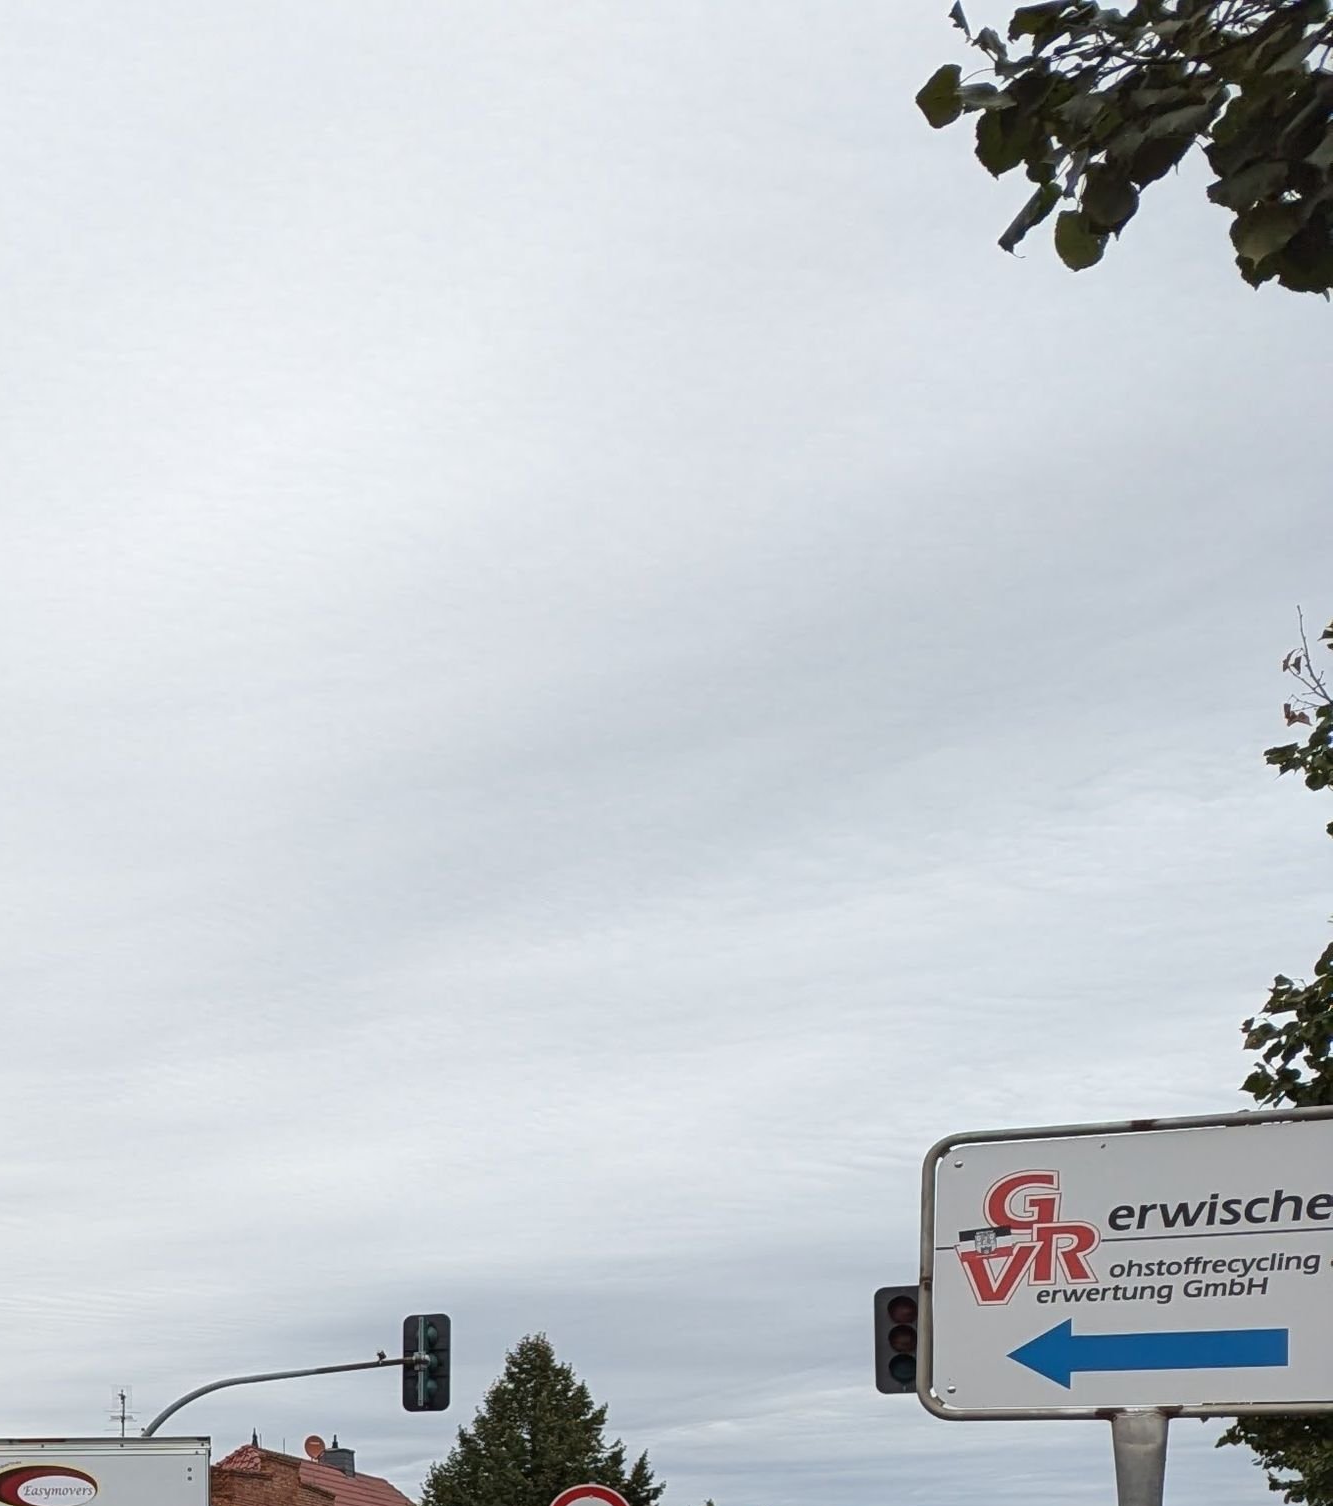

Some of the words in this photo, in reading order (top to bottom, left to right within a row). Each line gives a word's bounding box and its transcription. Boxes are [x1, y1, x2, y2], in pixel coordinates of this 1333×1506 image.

[1108, 1252, 1321, 1279] ohstoffrecycling
[1036, 1283, 1174, 1305] erwertung
[1183, 1276, 1269, 1298] GmbH
[23, 1485, 94, 1500] Easymovers
